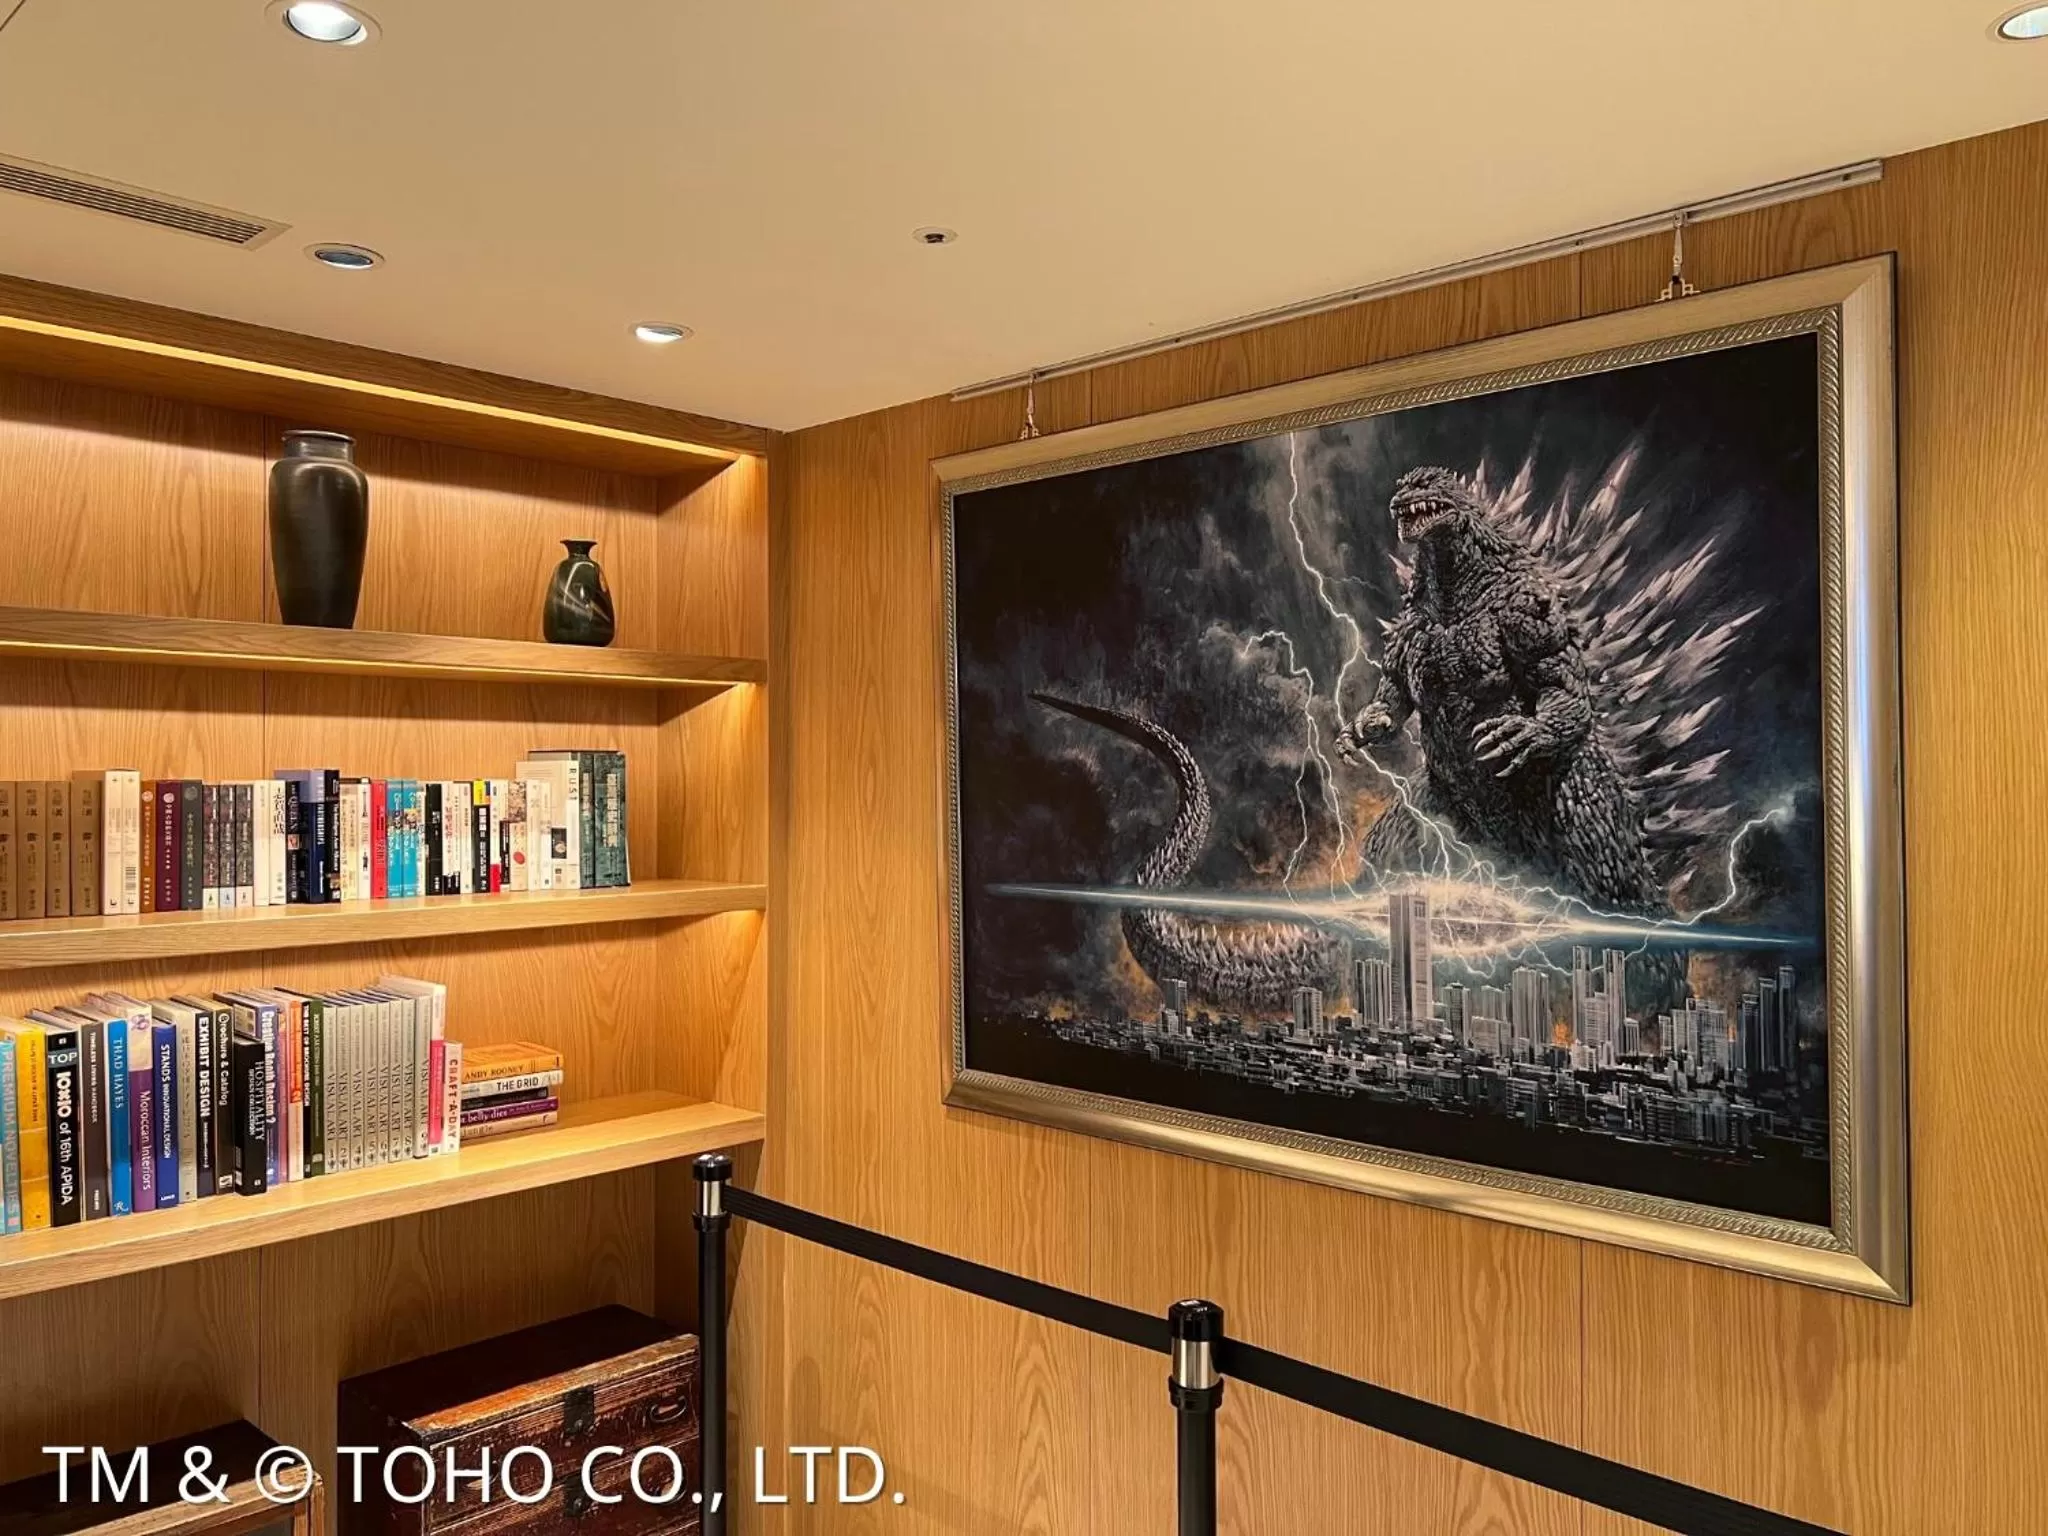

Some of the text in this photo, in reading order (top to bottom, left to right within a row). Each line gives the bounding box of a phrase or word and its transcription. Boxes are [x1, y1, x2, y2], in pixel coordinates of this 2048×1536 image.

[47, 1052, 78, 1064] TOP
[199, 1017, 210, 1067] EXHIBIT
[113, 1037, 124, 1109] THAD HAYES
[161, 1044, 172, 1082] STANDS
[465, 1071, 488, 1080] ANDY
[199, 1070, 211, 1117] DESIGN
[218, 1070, 229, 1106] Catalog
[255, 1061, 266, 1140] HOSPITALITY
[327, 1073, 336, 1114] VISUAL
[339, 1072, 348, 1113] VISUAL
[353, 1071, 362, 1113] VISUAL
[367, 1068, 376, 1109] VISUAL
[380, 1066, 388, 1107] VISUAL
[391, 1064, 400, 1106] VISUAL
[403, 1063, 412, 1103] VISUAL
[496, 1077, 539, 1092] THE GRID
[3, 1051, 18, 1214] PREMIUM NOVELTIES
[59, 1122, 72, 1135] of
[327, 1120, 336, 1141] ART
[338, 1120, 348, 1140] ART
[353, 1117, 361, 1138] ART
[367, 1113, 376, 1135] ART
[379, 1111, 388, 1133] ART
[391, 1110, 400, 1132] ART
[403, 1107, 412, 1130] ART
[467, 1111, 488, 1123] belly
[60, 1138, 73, 1163] 16th
[140, 1090, 152, 1190] Moroccan Interiors
[61, 1166, 73, 1206] APIDA
